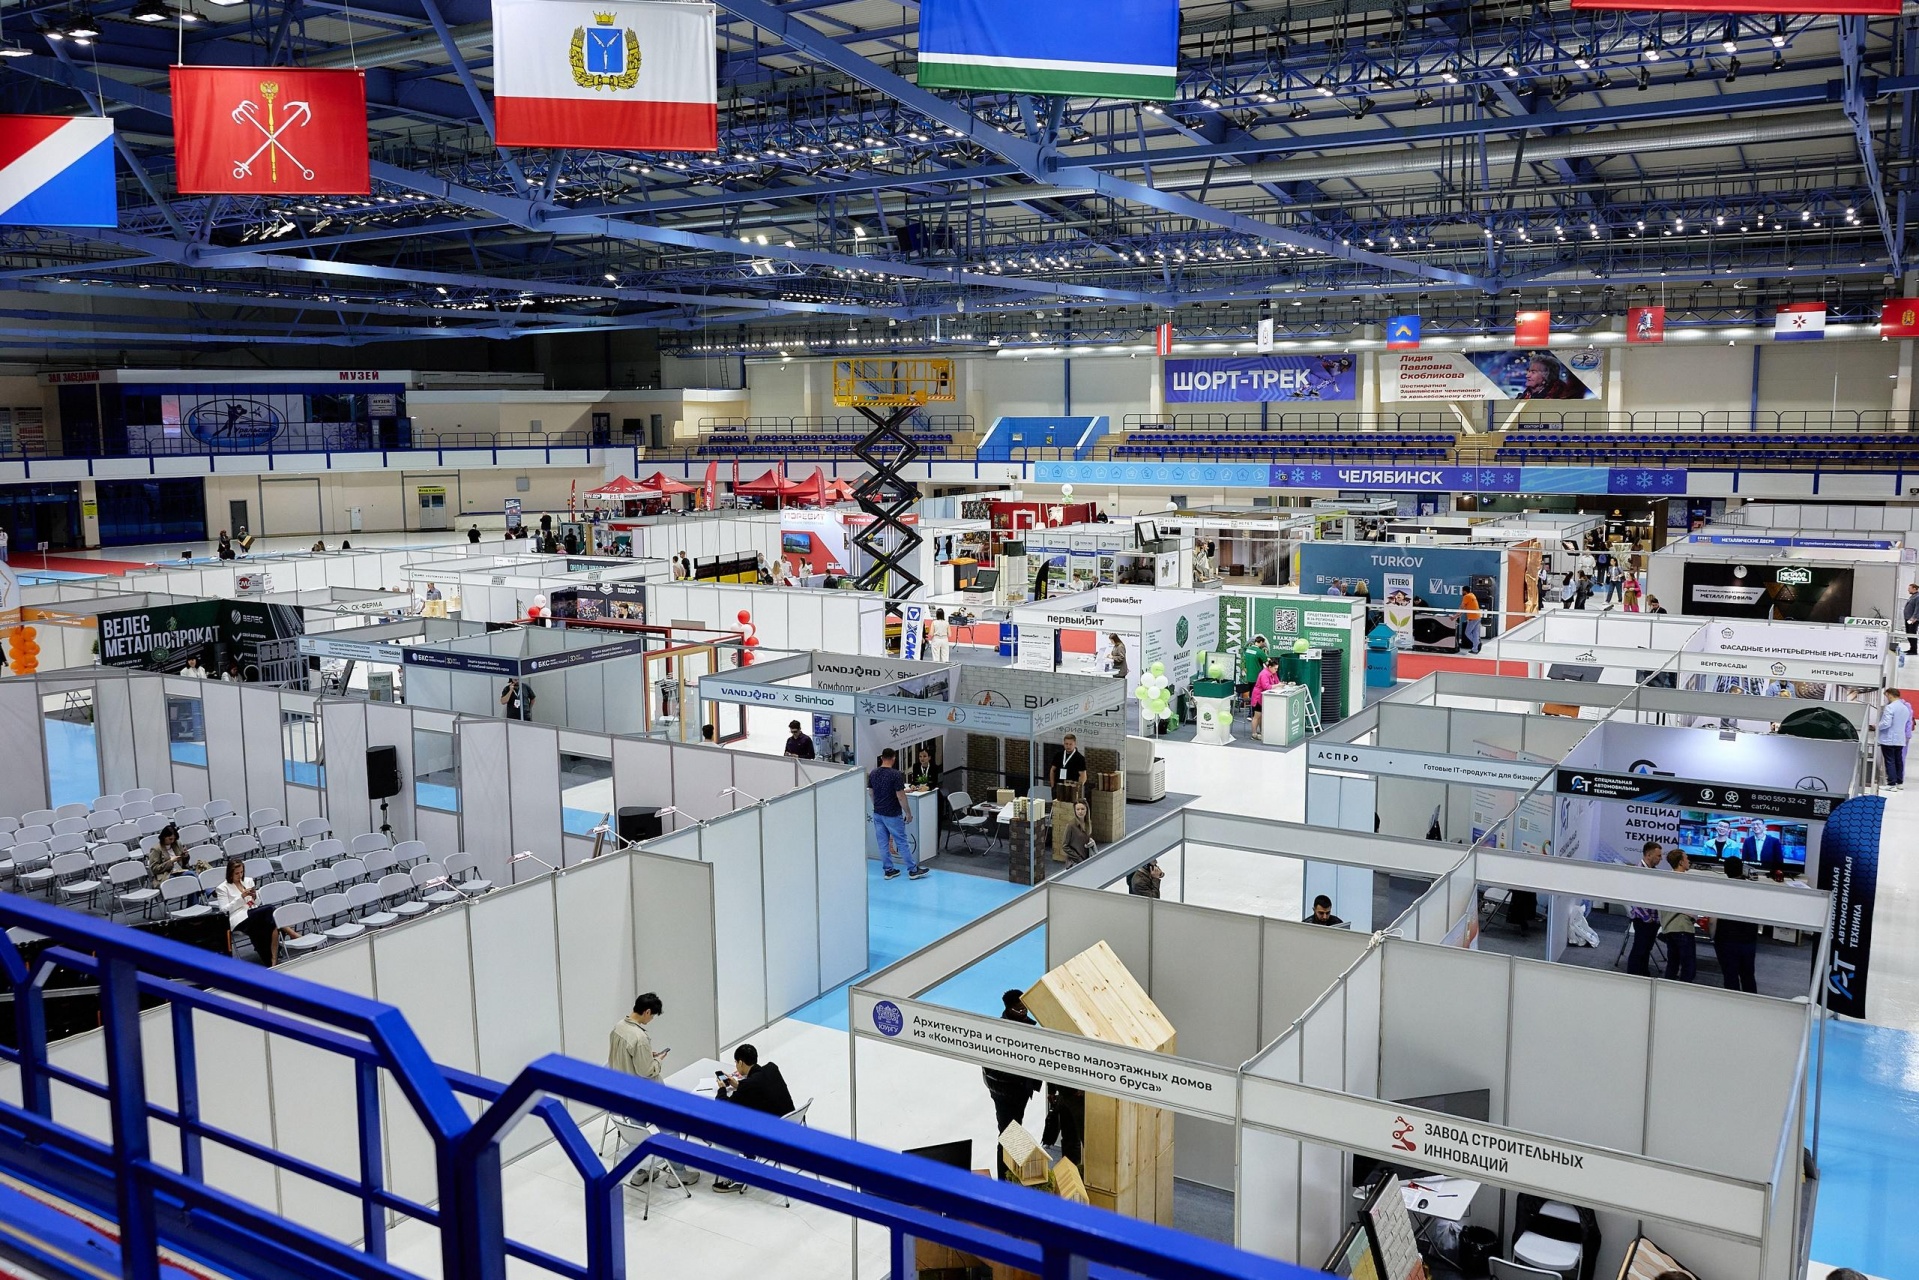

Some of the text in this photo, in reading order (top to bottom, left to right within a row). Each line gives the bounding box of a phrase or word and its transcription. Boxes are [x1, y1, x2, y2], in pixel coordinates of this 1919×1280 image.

[339, 370, 380, 380] МУЗЕЙ
[1173, 368, 1310, 391] ШОРТ-ТРЕК
[1338, 470, 1442, 484] ЧЕЛЯБИНСК
[1370, 555, 1424, 568] TURKOV
[1442, 585, 1464, 595] VET
[351, 601, 383, 611] СК-ФЕРМА
[242, 614, 263, 624] ВЕЛЕС
[1856, 619, 1889, 627] FAKRO
[103, 615, 150, 638] ВЕЛЕС
[104, 625, 220, 657] МЕТАЛЛОПРОКАТ
[905, 622, 918, 659] XCM
[1174, 650, 1190, 661] МАЛАХИТ
[1720, 644, 1764, 652] ФАСАДНЫЕ
[1771, 647, 1827, 656] ИНТЕРЬЕРНЫЕ
[1828, 651, 1878, 660] HPL-ПАНЕЛИ
[1700, 661, 1747, 669] ВЕНТФАСАДЫ
[1811, 669, 1854, 677] ИНТЕРЬЕРЫ
[794, 695, 834, 705] Shinhoo
[877, 703, 937, 717] ВИНЗЕР
[1044, 704, 1079, 723] ВИНЗЕР
[1056, 727, 1099, 735] ериалов
[1318, 751, 1359, 762] АСПРО
[1424, 764, 1452, 772] Готовые
[1453, 767, 1497, 778] IT-продукты
[1594, 784, 1640, 792] АВТОМОБИЛЬНАЯ
[1627, 805, 1680, 818] СПЕЦИАЛ
[1625, 832, 1679, 845] ТЕХНИКА
[1838, 856, 1853, 945] АВТОМОБИЛЬНАЯ
[1850, 904, 1862, 948] ТЕХНИКА
[913, 1015, 982, 1040] Архитектура
[994, 1035, 1081, 1062] строительство
[1083, 1055, 1168, 1080] малоэтажных
[1171, 1074, 1212, 1092] домов
[913, 1029, 1162, 1094] из «Композиционного деревянного бруса»
[1424, 1123, 1584, 1169] ЗАВОД СТРОИТЕЛЬНЫХ
[1424, 1143, 1508, 1173] ИННОВАЦИЙ
